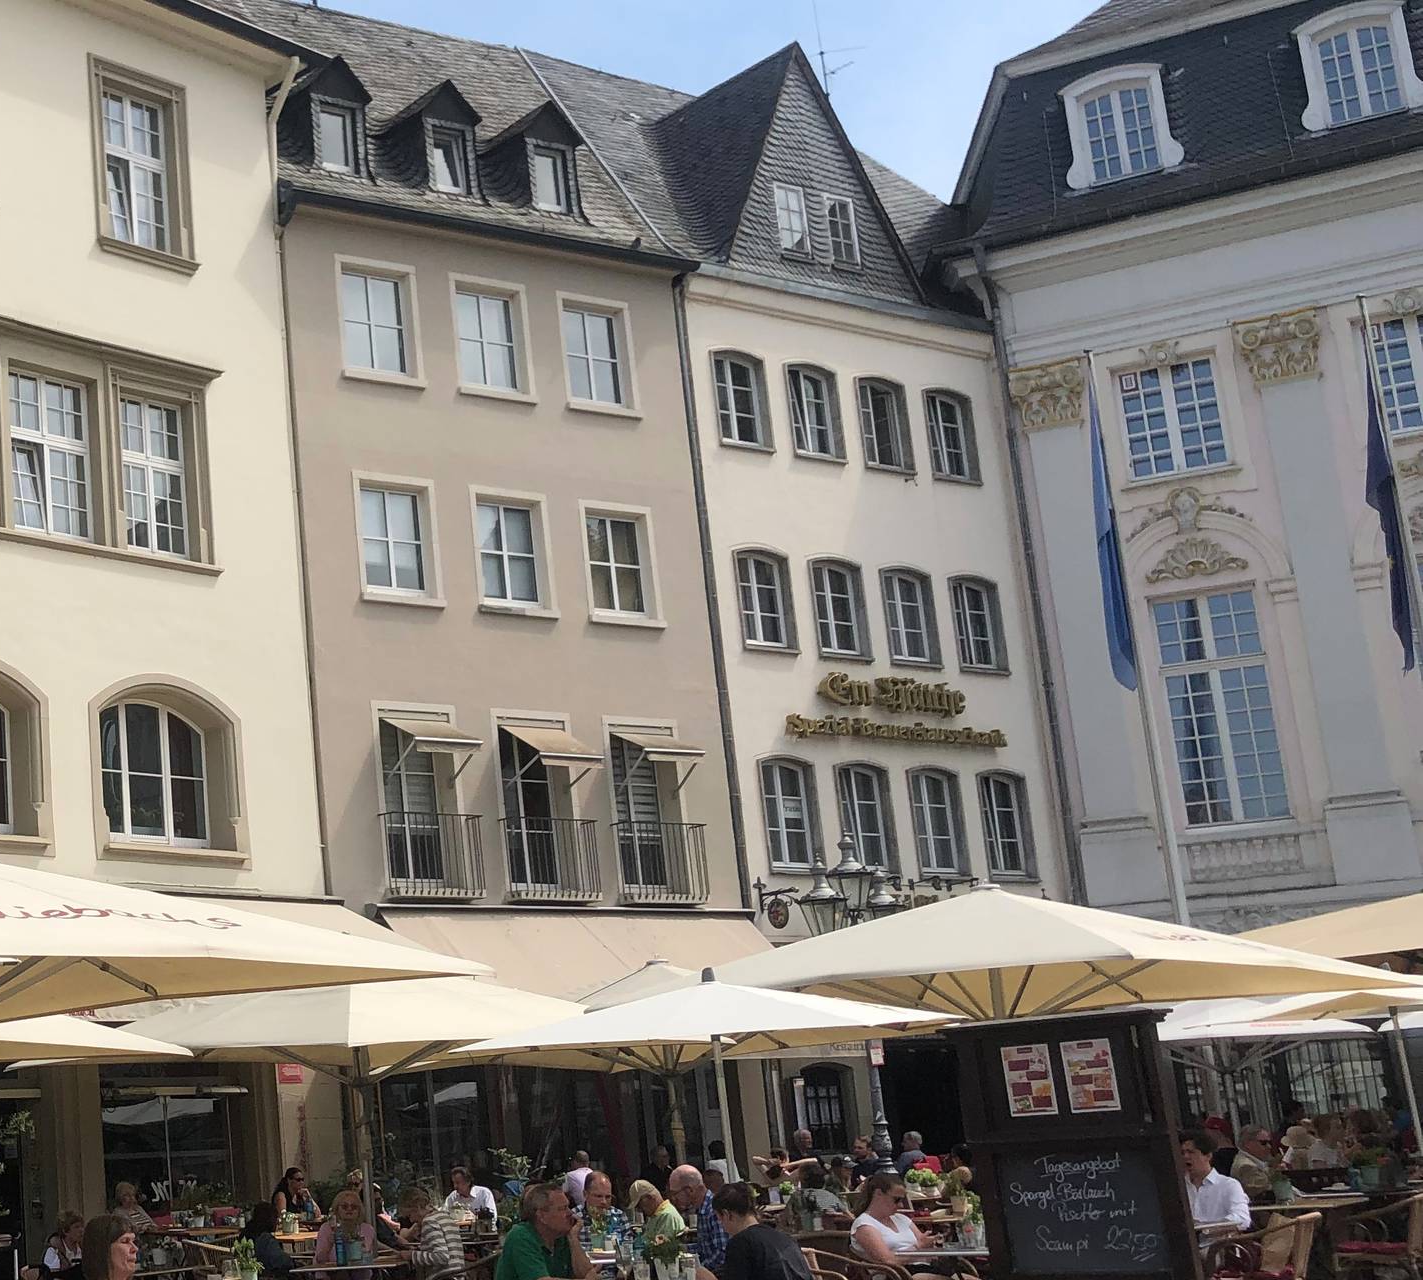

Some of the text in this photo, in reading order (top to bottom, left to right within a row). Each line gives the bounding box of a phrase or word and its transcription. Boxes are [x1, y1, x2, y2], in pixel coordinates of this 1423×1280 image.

[1034, 1152, 1121, 1182] Tagesangebot
[1109, 1200, 1137, 1218] mit
[1035, 1225, 1089, 1256] Scampi
